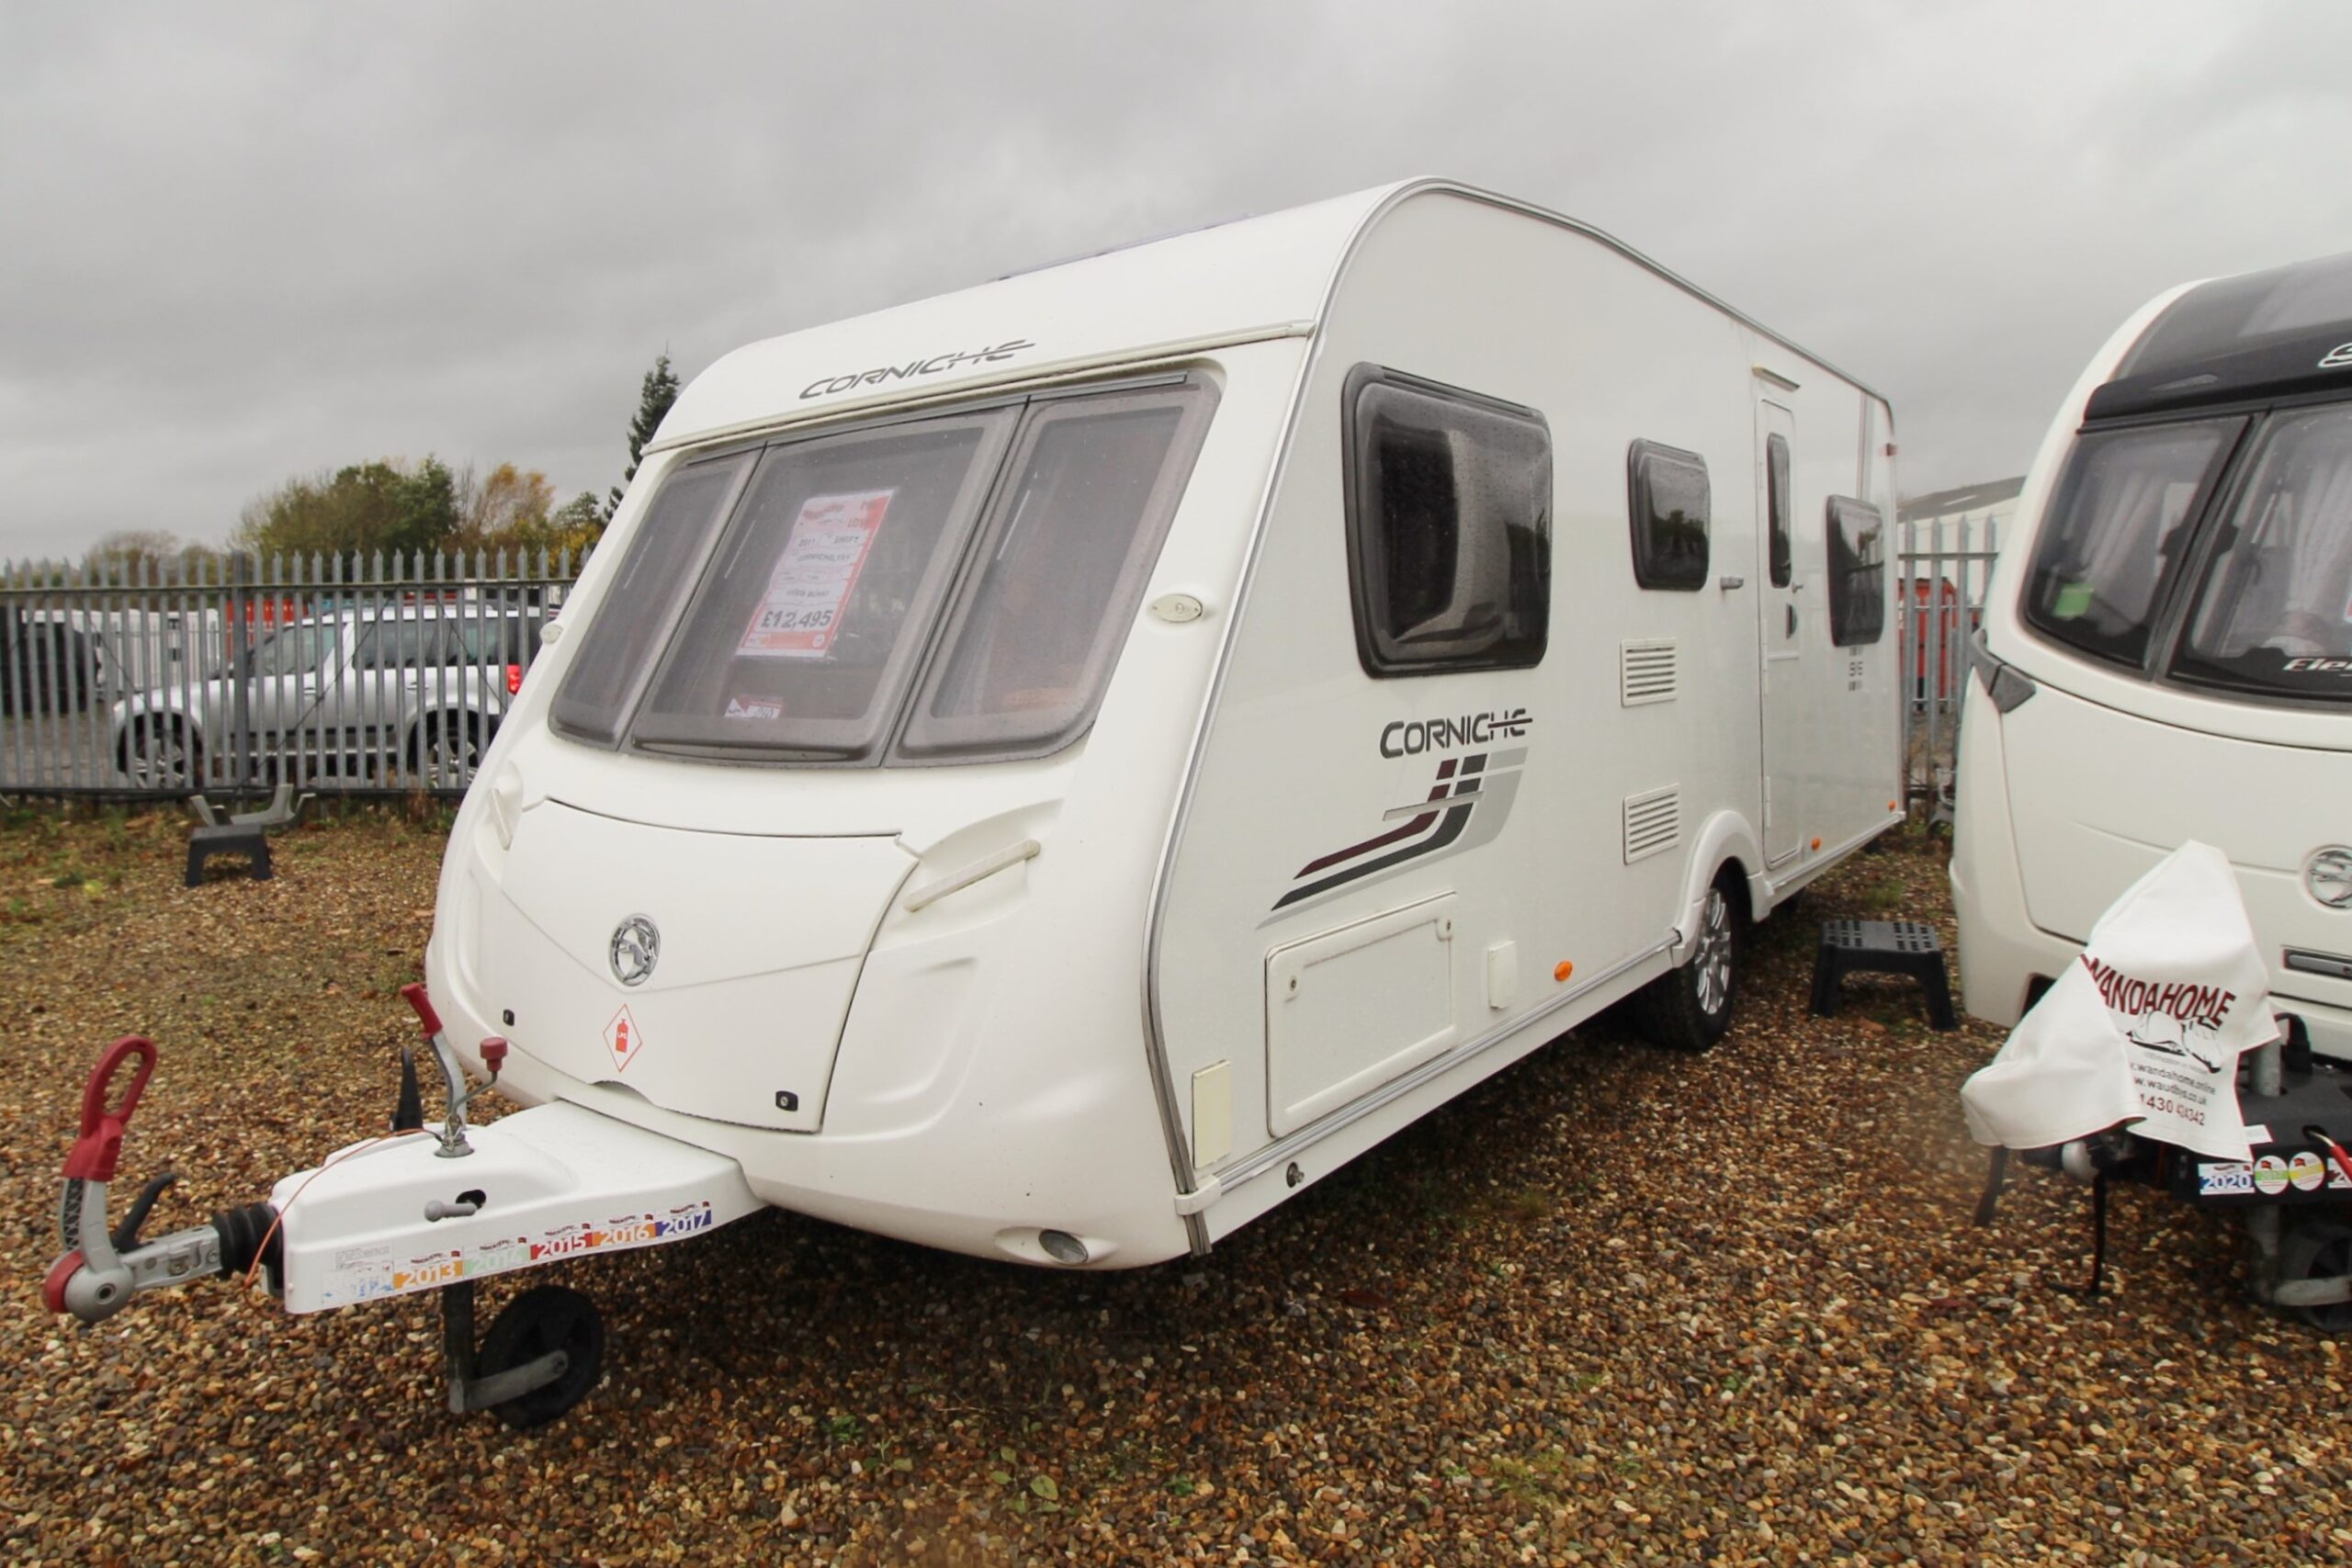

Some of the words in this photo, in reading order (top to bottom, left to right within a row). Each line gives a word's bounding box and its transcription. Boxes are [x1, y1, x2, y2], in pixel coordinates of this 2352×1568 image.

[798, 339, 1036, 400] CORNICHE
[761, 610, 834, 630] £12,495
[1380, 708, 1533, 759] CORNICHE
[2080, 953, 2237, 1027] WANDAHOME
[2202, 1174, 2251, 1190] 2020
[404, 1261, 457, 1287] 2013
[473, 1247, 525, 1274] 2014
[537, 1234, 587, 1260] 2015
[599, 1224, 650, 1245] 2016
[662, 1212, 707, 1236] 2017
